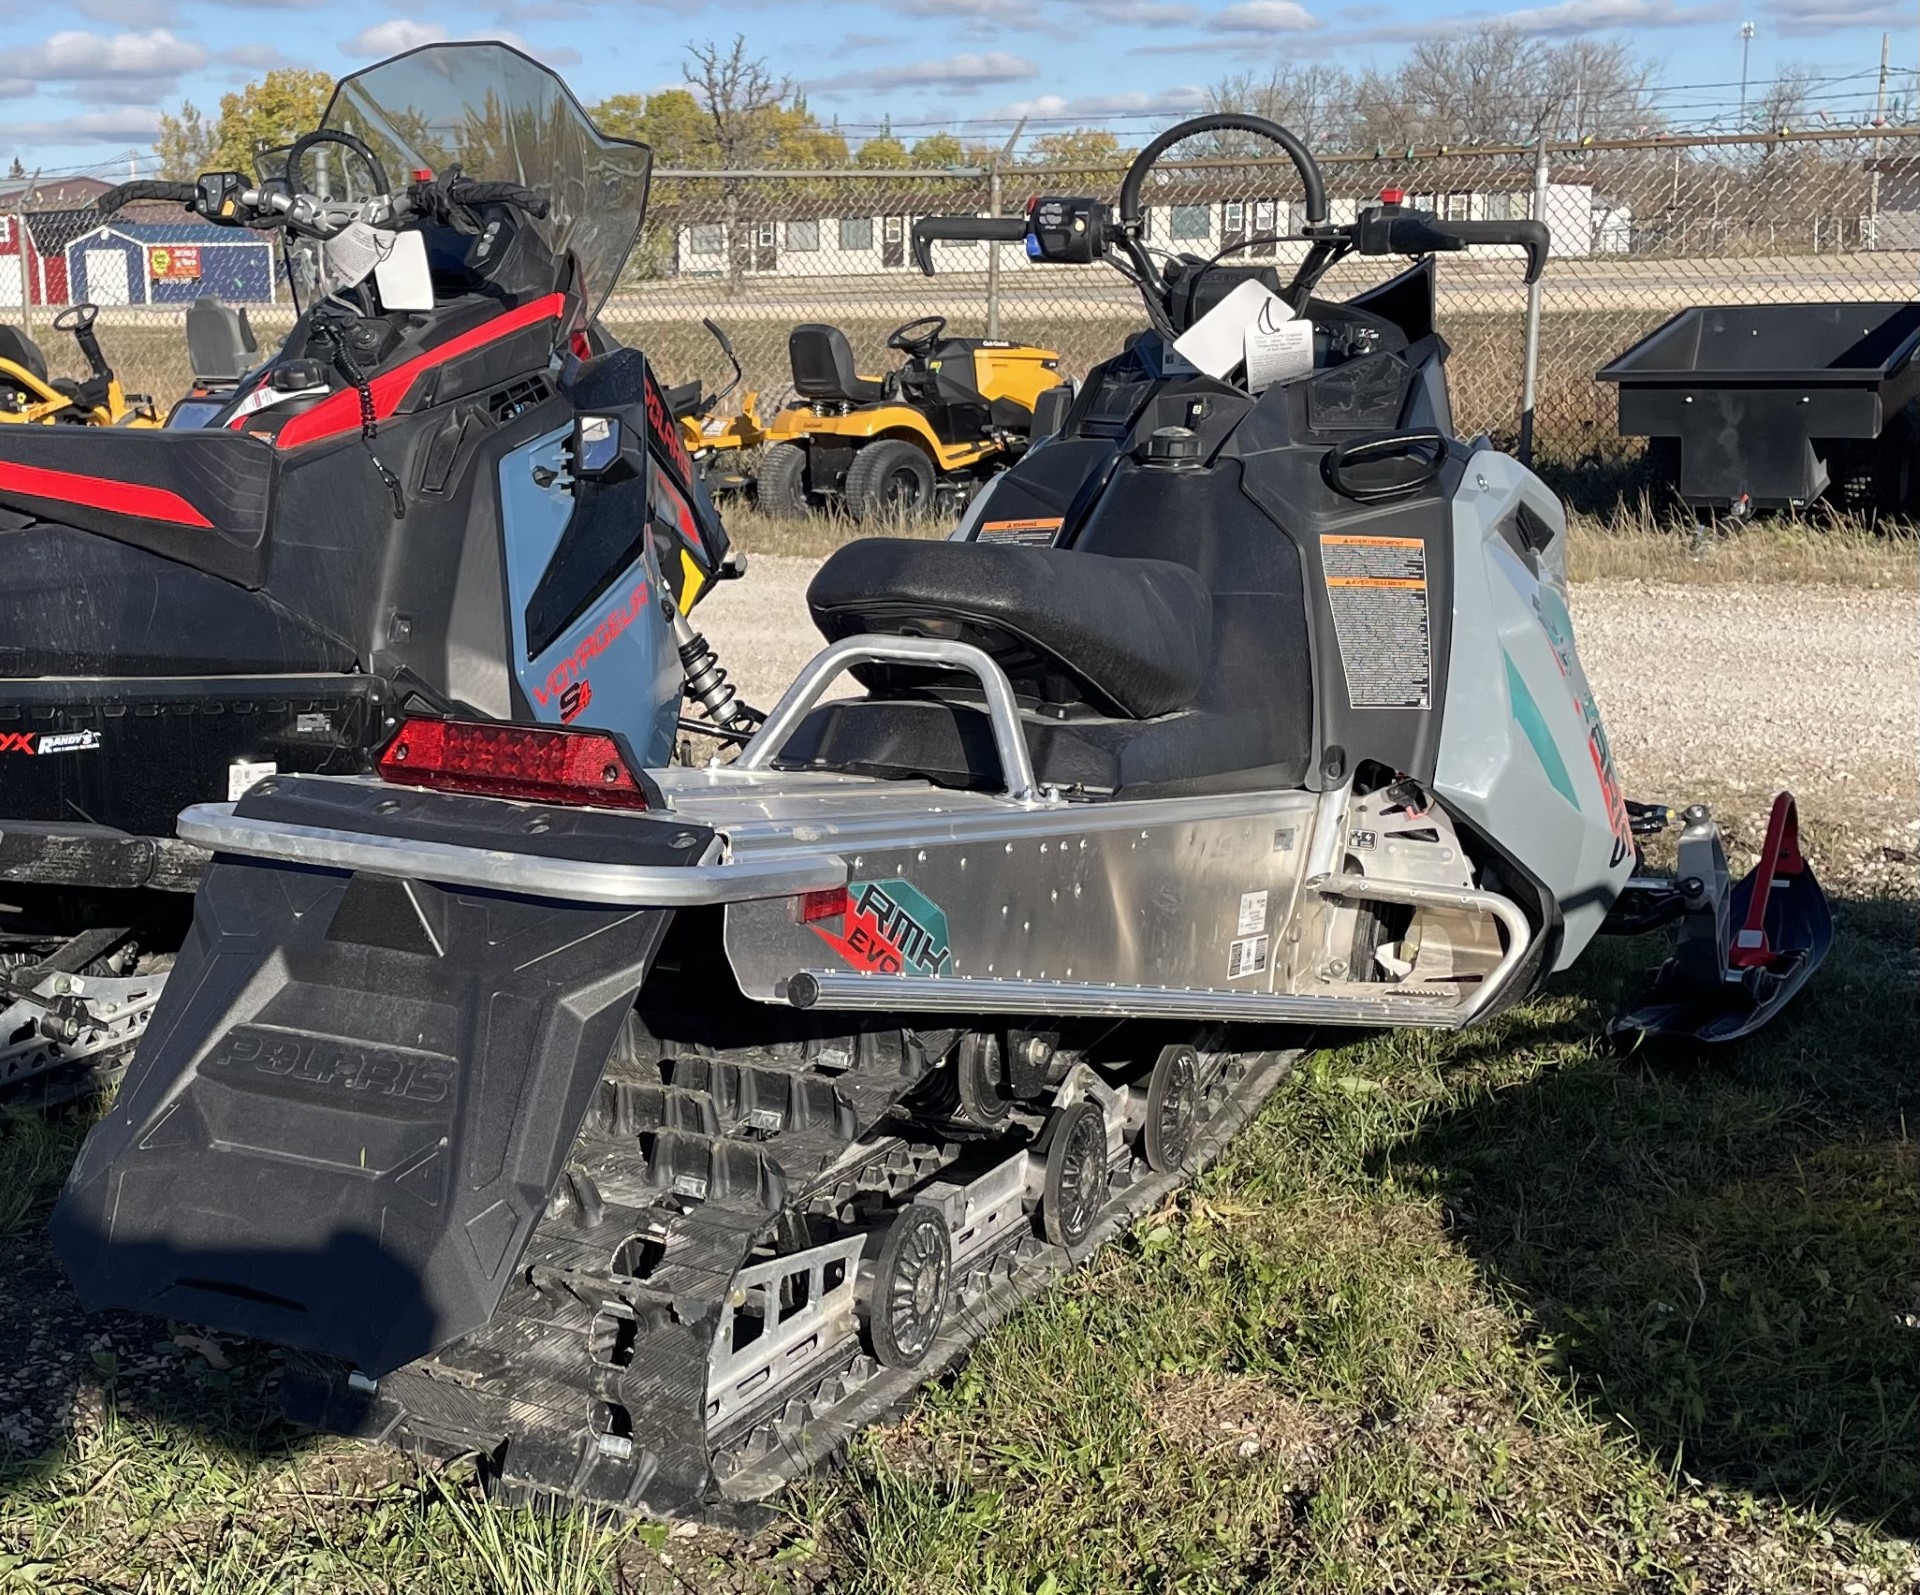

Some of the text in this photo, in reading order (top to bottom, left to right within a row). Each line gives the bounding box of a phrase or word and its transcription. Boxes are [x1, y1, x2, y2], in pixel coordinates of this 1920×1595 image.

[643, 376, 692, 487] POLARIS
[532, 581, 649, 707] VOYAGEUR
[848, 926, 900, 973] EVO
[855, 883, 951, 976] RMK
[216, 1037, 455, 1103] POLARIS
